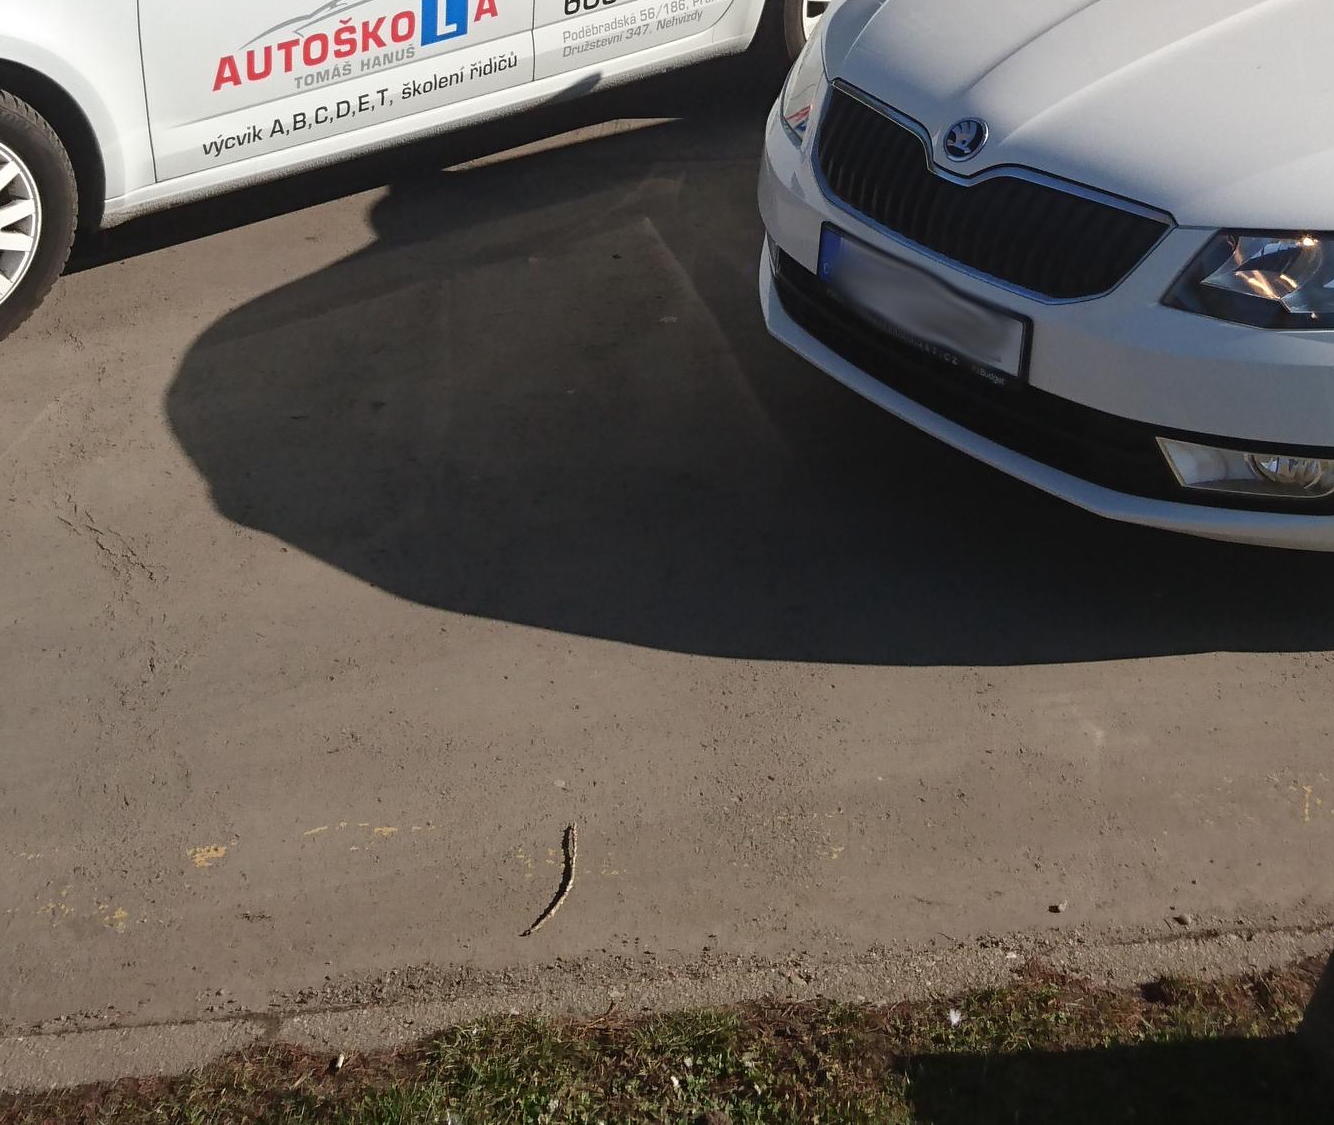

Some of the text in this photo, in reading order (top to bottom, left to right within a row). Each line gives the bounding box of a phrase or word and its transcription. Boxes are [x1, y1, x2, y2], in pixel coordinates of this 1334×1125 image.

[202, 123, 263, 157] výcvik
[401, 65, 465, 100] školení
[470, 50, 518, 85] řidičů
[294, 44, 415, 90] TOMÁŠ HANUŠ
